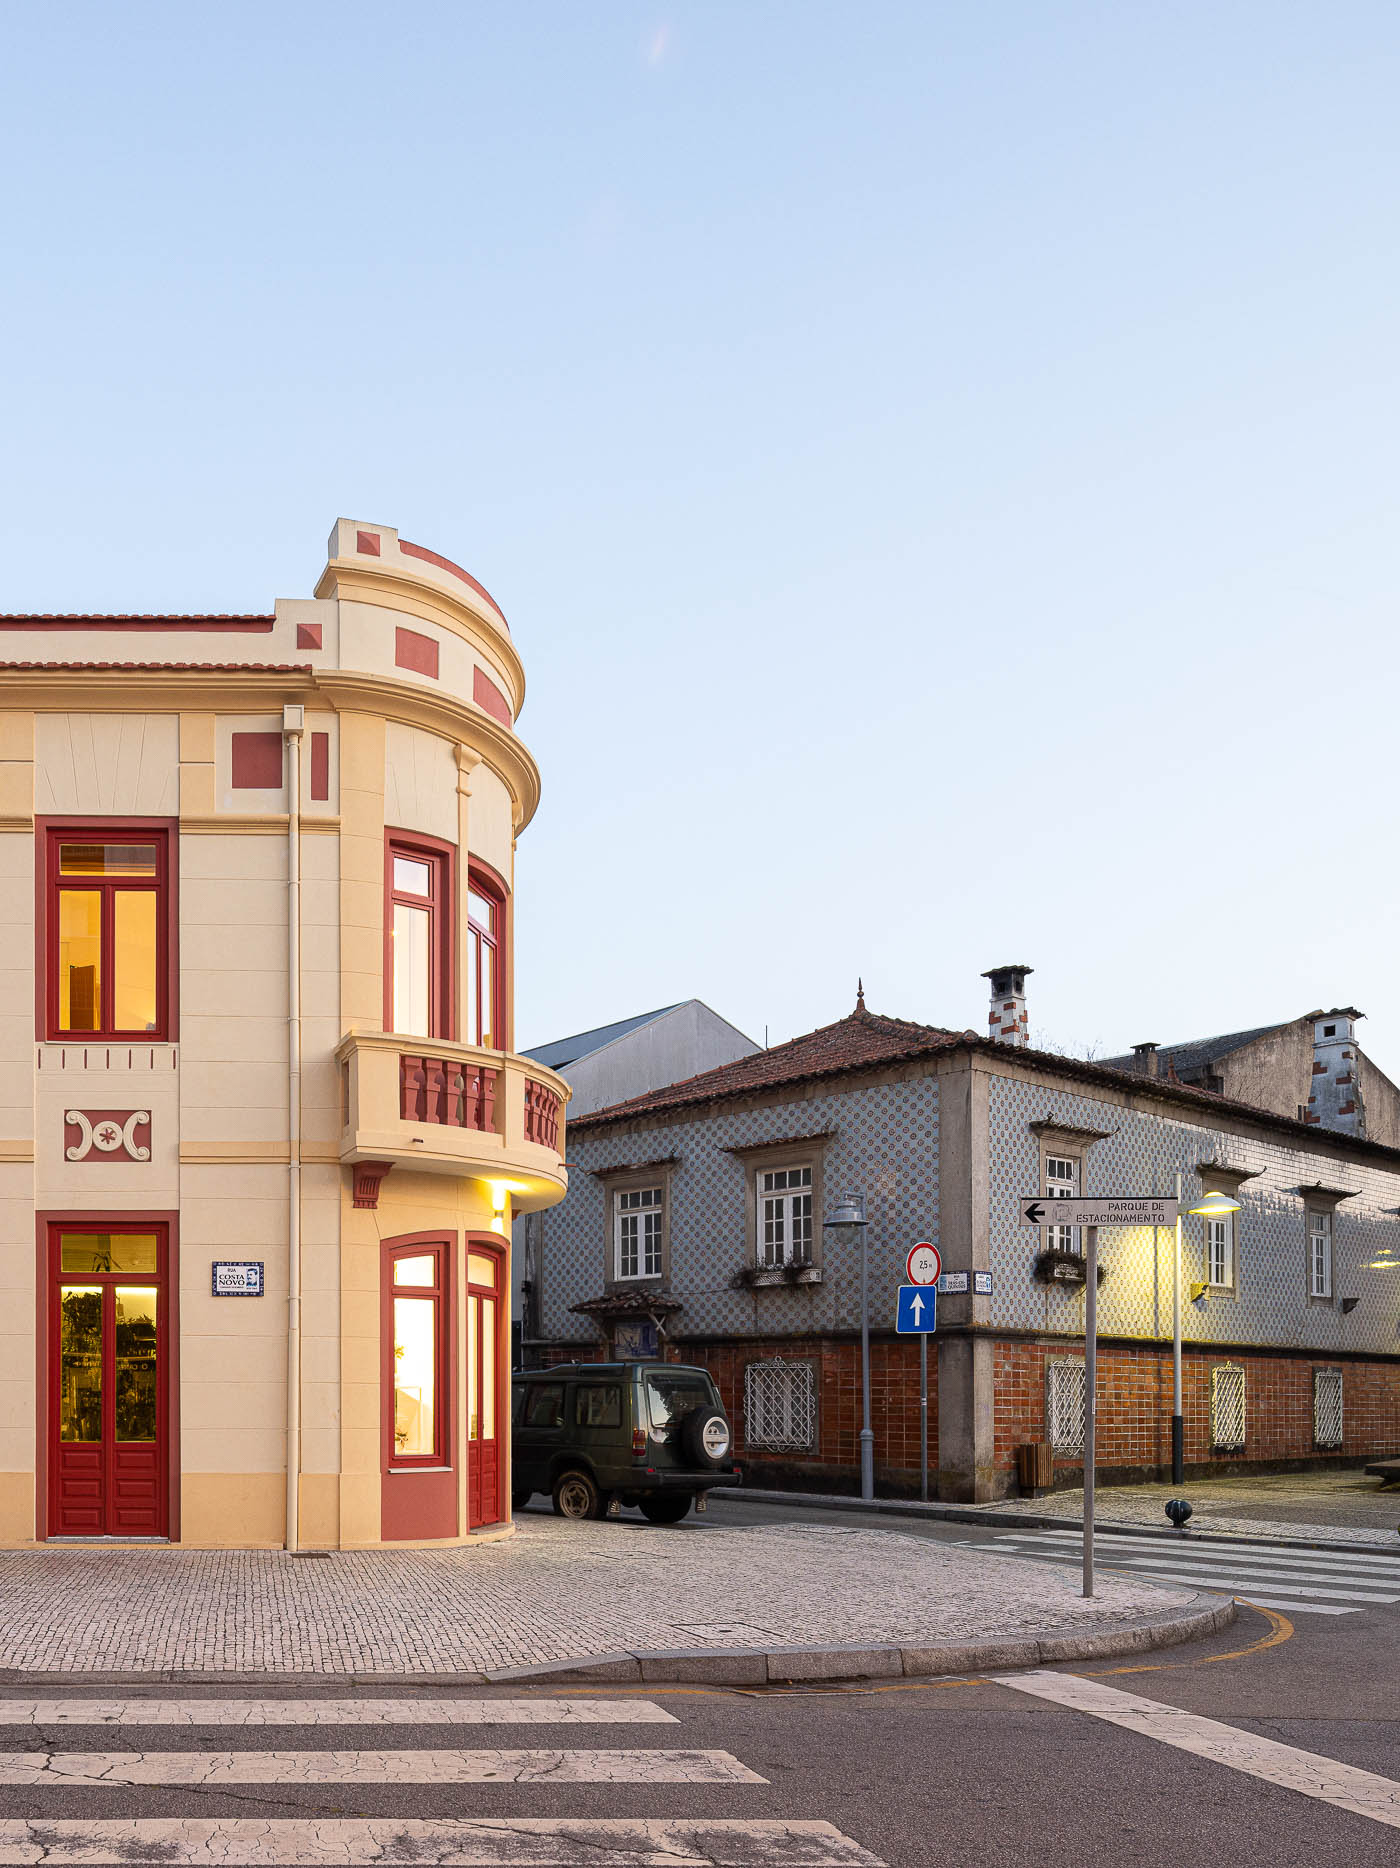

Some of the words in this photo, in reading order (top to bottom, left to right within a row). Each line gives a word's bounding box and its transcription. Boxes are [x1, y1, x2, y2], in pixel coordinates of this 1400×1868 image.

[1108, 1202, 1148, 1211] PARQUE
[1151, 1202, 1165, 1211] DE
[1076, 1213, 1165, 1223] ESTACIONAMENTO
[919, 1260, 928, 1270] 2,5
